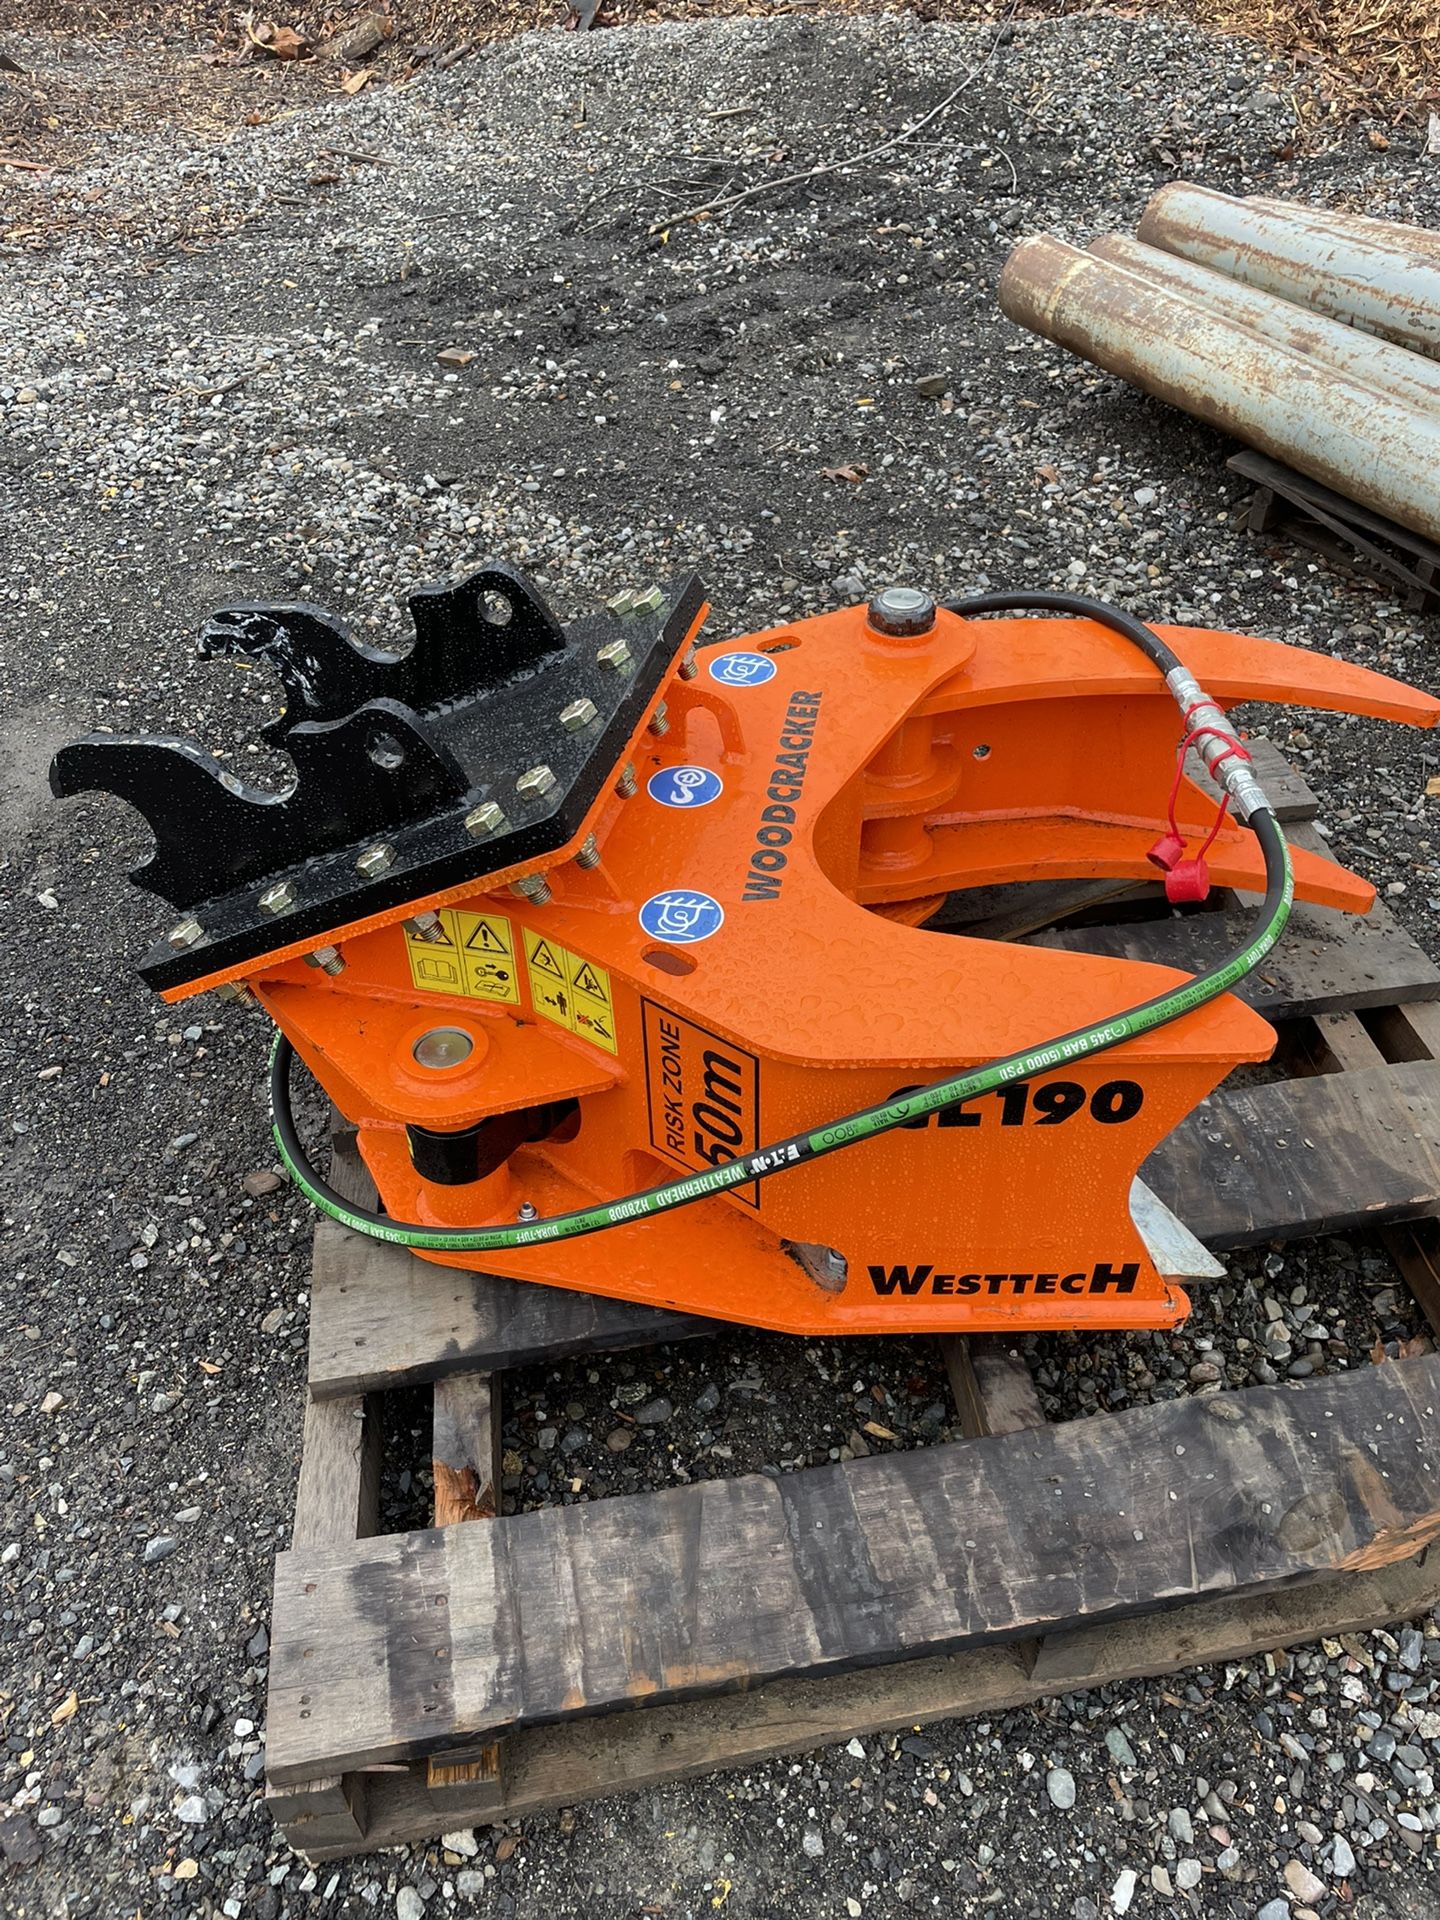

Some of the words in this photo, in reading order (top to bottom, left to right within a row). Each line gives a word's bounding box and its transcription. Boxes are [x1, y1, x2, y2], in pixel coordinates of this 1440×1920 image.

[742, 691, 822, 901] WOODCRACKER
[1062, 1036, 1088, 1059] BAR
[1091, 1026, 1113, 1048] 345
[660, 1018, 682, 1095] ZONE
[1000, 1060, 1025, 1080] PSI)
[1028, 1048, 1061, 1070] (5000
[693, 1050, 743, 1166] 50m
[664, 1095, 685, 1155] RISK
[656, 1164, 747, 1206] WEATHERHEAD
[609, 1198, 650, 1222] H28008
[867, 1263, 1140, 1296] WESTTECH
